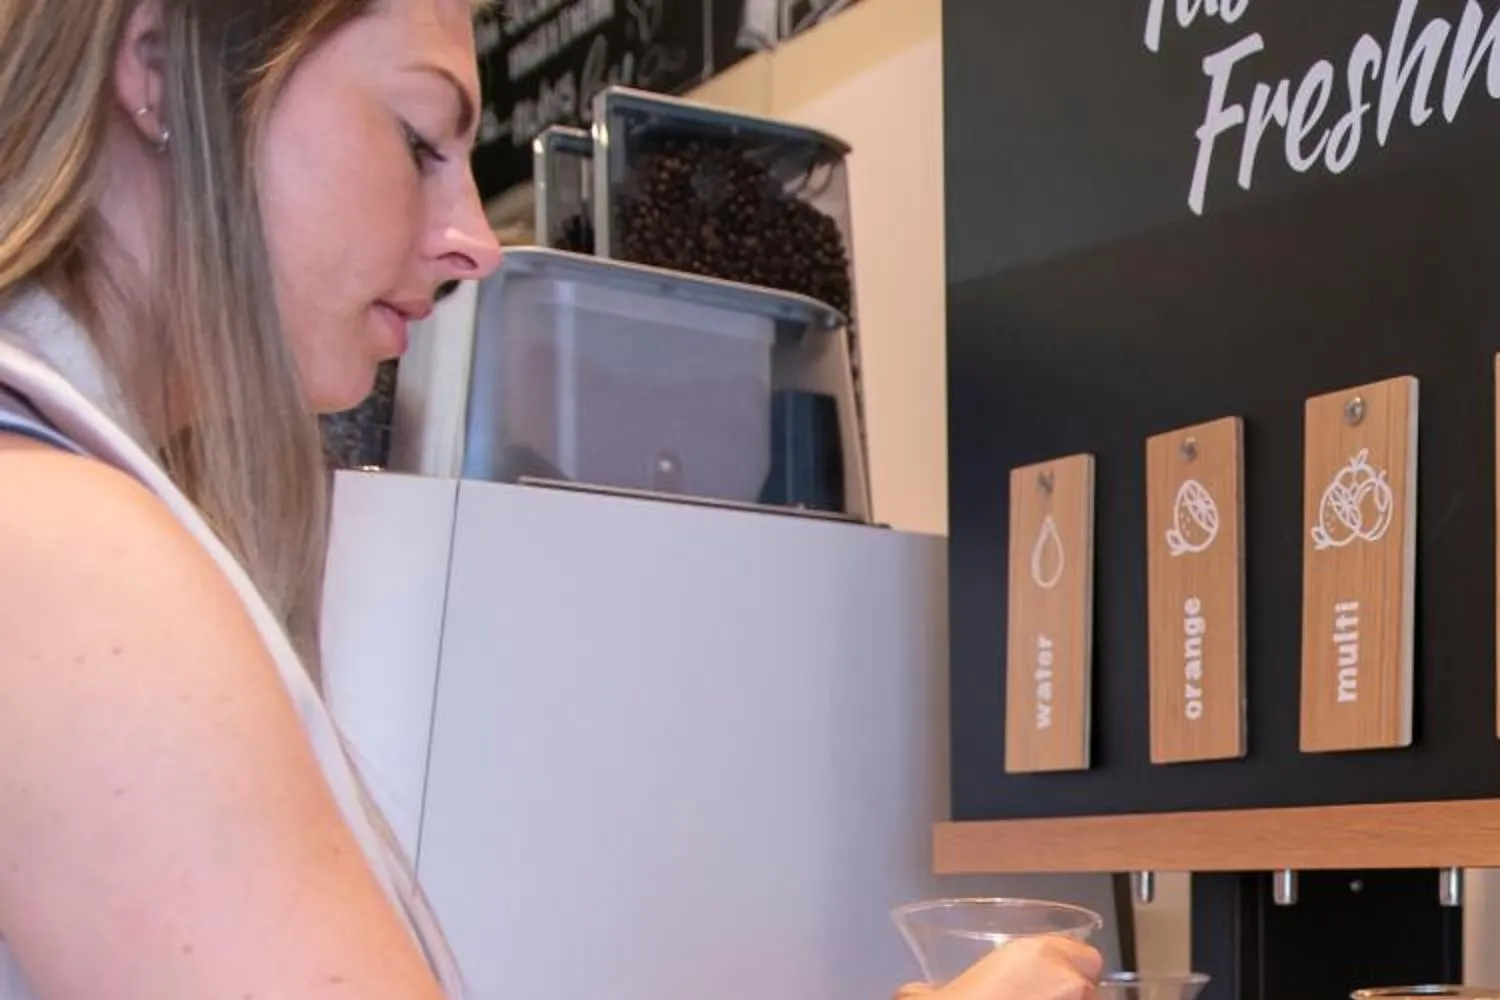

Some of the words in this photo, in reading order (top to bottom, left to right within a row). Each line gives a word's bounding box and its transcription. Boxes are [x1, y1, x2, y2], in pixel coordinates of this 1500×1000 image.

[1035, 634, 1055, 730] water
[1183, 597, 1206, 721] orange
[1333, 600, 1360, 704] multi
